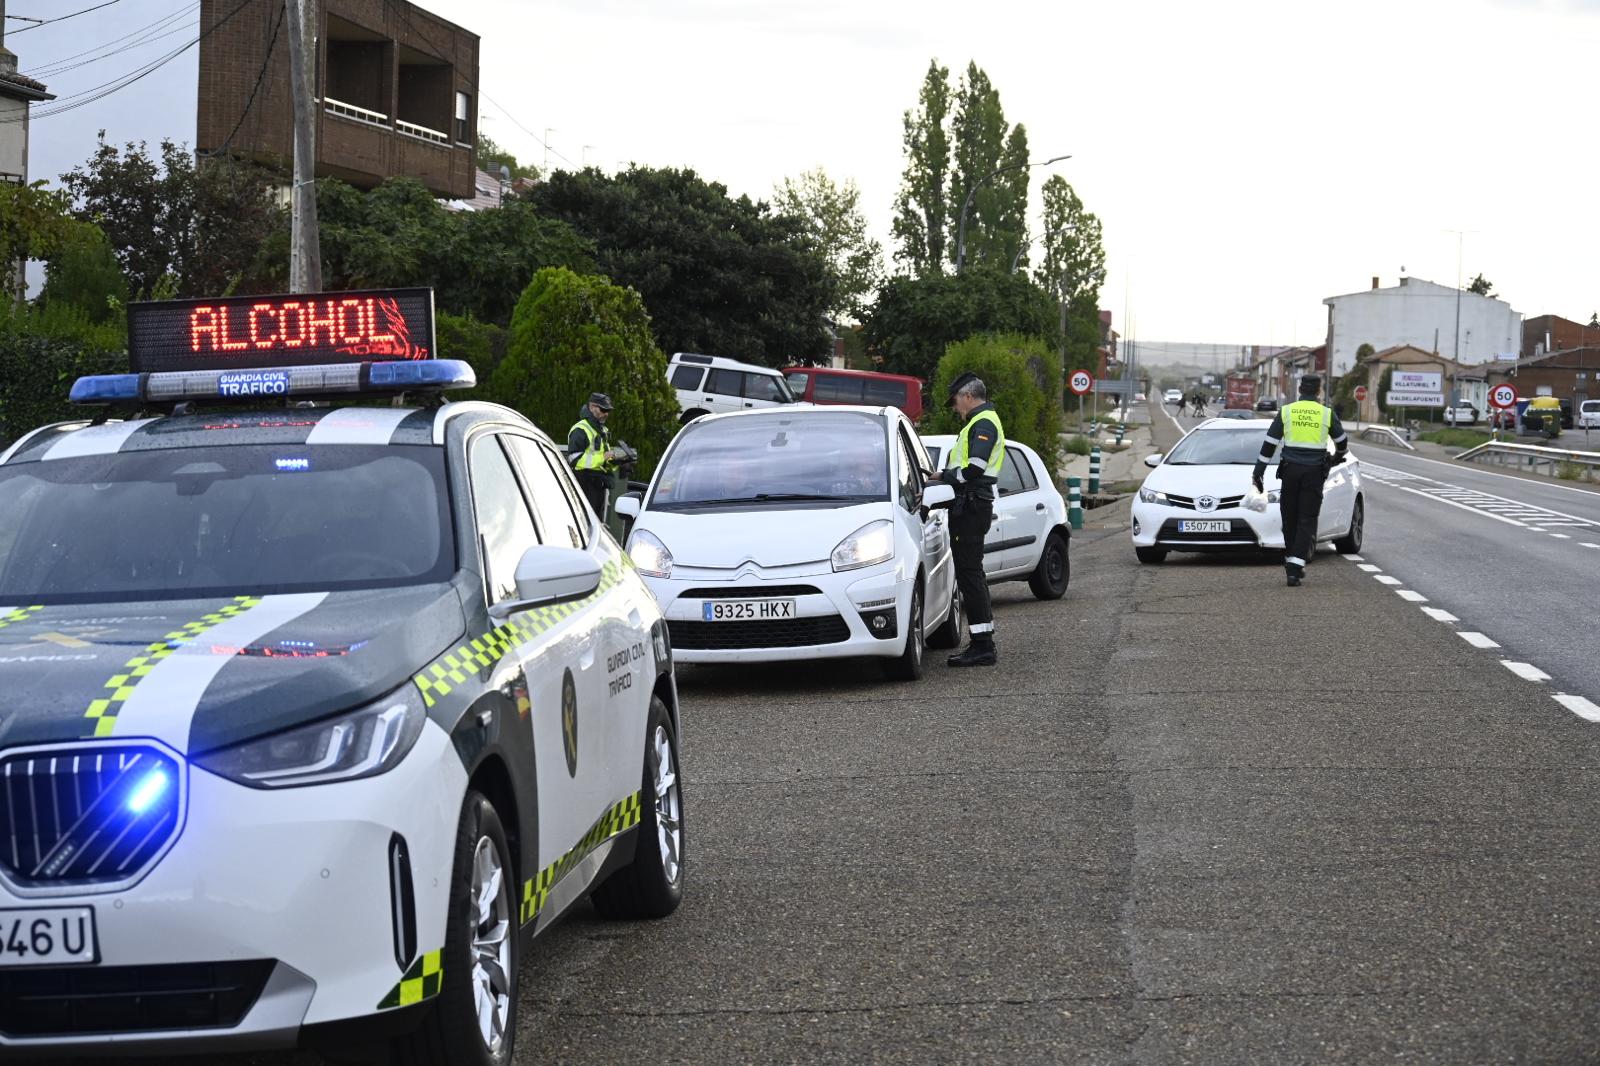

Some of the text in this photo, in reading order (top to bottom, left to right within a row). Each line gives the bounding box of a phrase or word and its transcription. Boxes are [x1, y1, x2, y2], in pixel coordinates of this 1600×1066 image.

[190, 298, 395, 352] ALCOHOL
[220, 372, 286, 383] GUARDIA CIVIL
[1074, 377, 1088, 386] 50
[1497, 391, 1512, 401] 50
[1184, 521, 1228, 532] 5507 HTL
[714, 602, 790, 619] 9325 HKX
[607, 642, 645, 673] GUARDIA CIVIL
[0, 917, 85, 957] 46 U
